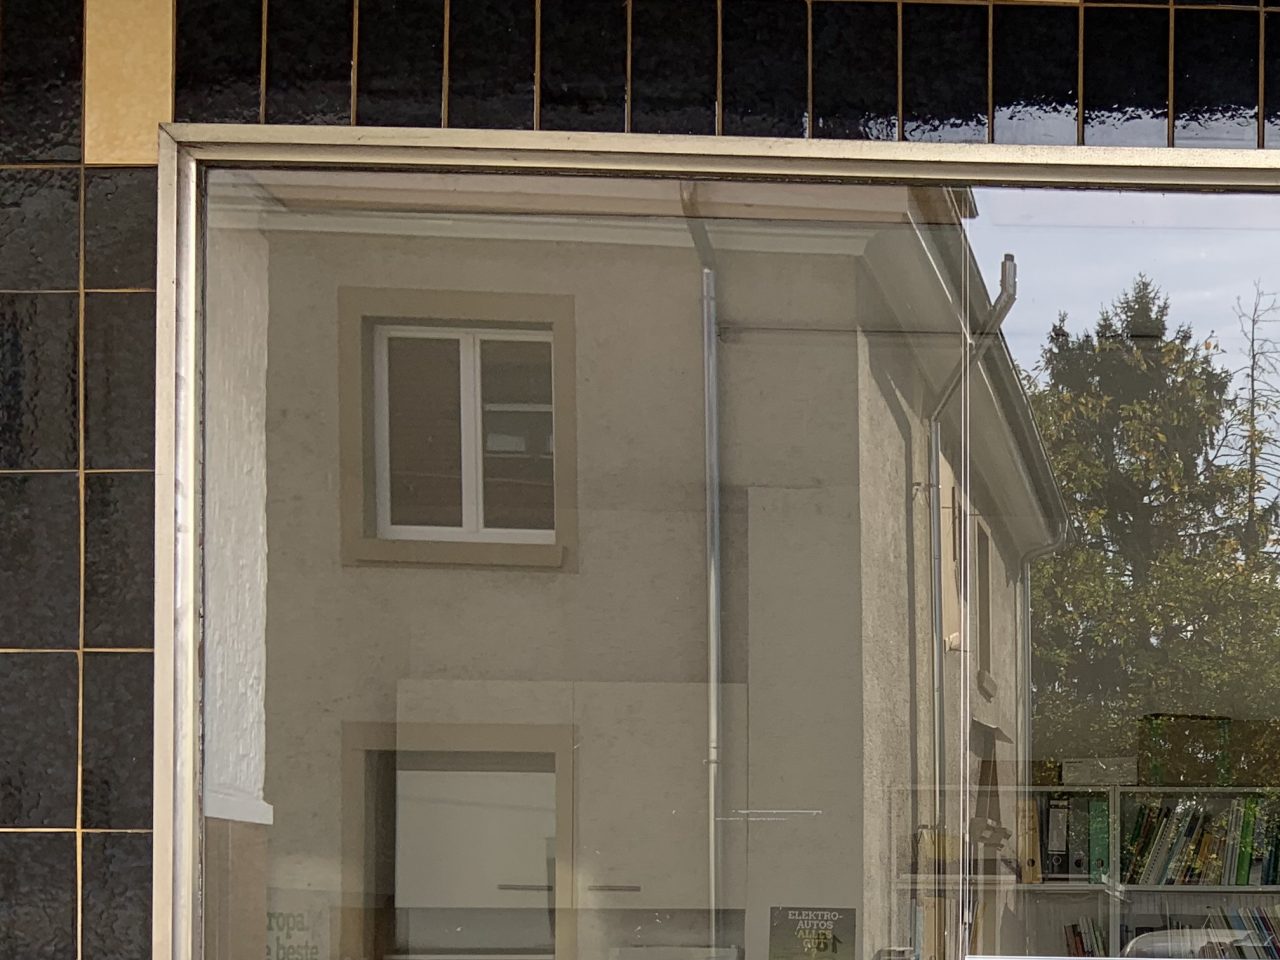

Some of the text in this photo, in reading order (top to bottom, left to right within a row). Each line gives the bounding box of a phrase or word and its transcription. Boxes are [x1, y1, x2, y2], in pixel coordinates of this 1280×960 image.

[788, 911, 843, 920] ELEKTRO-
[797, 920, 834, 929] AUTOS
[797, 930, 832, 939] ALLES
